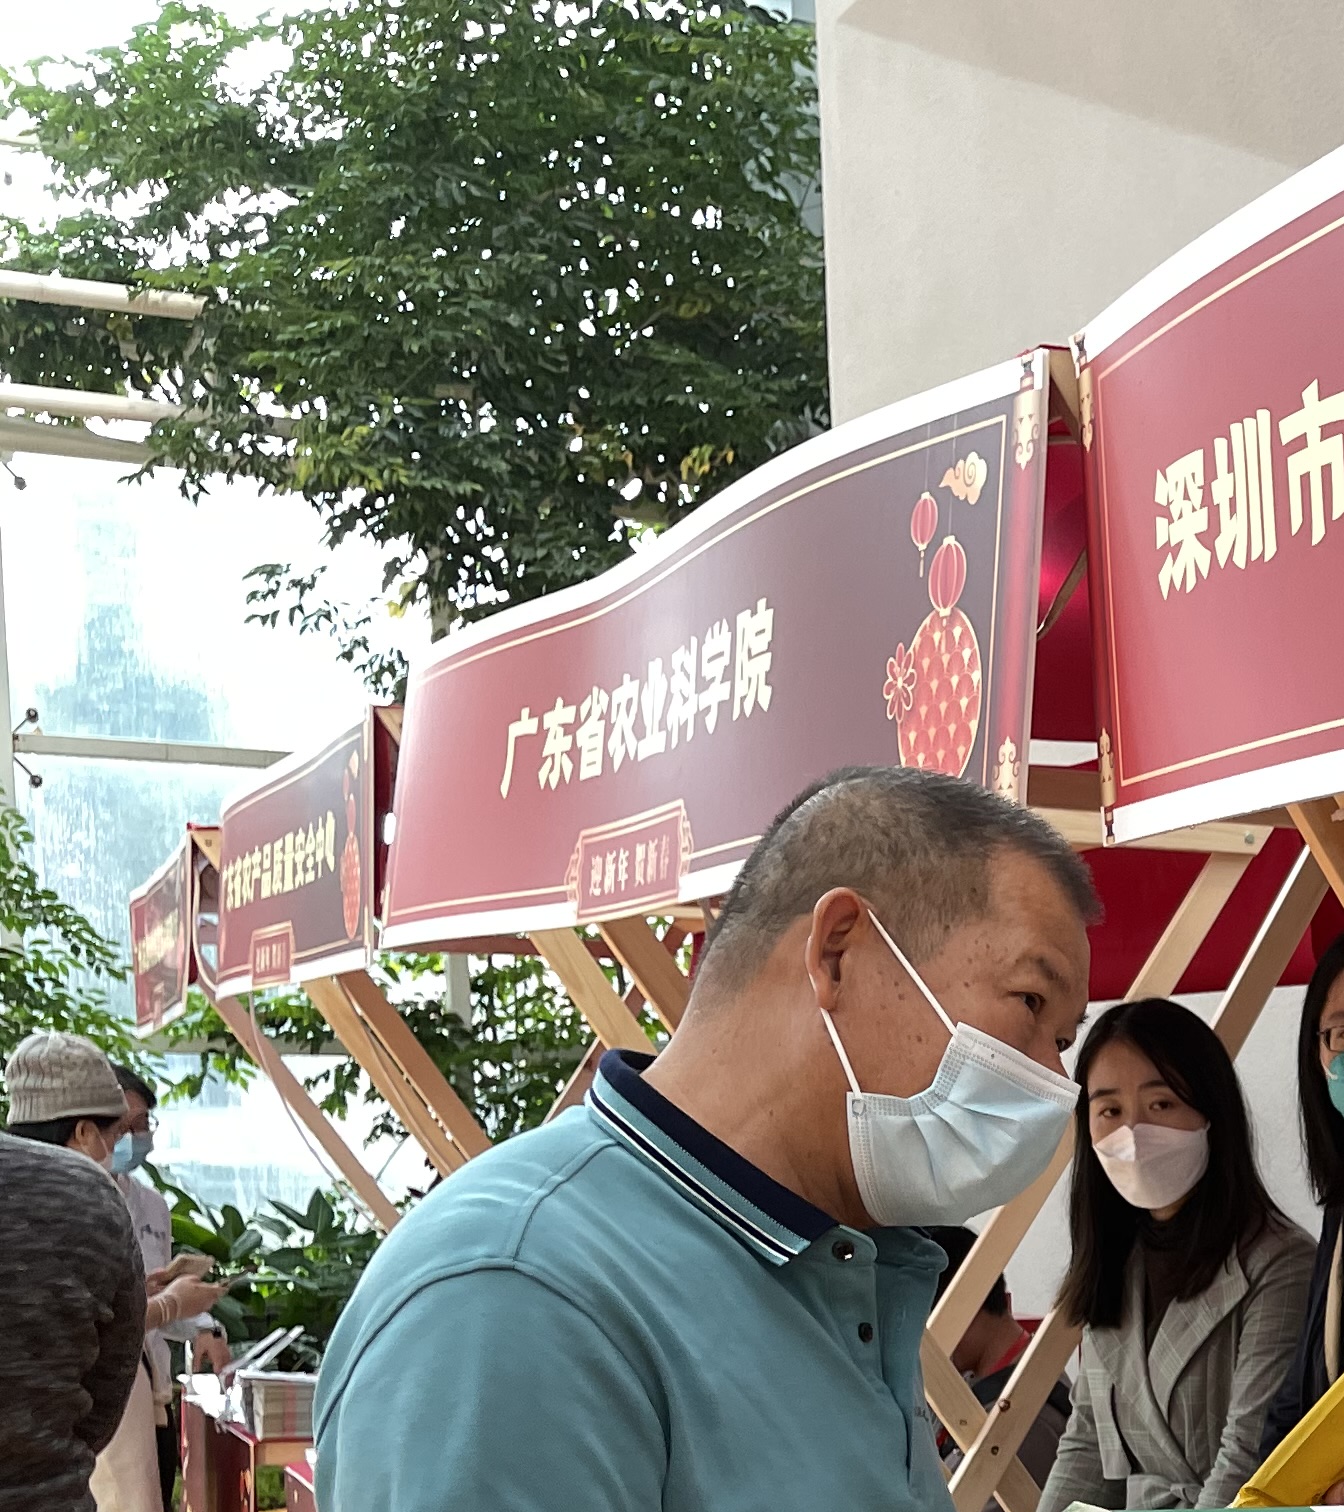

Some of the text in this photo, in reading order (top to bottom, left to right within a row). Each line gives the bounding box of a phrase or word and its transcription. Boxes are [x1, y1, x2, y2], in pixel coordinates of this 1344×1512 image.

[500, 597, 774, 799] 广东省农业科学院
